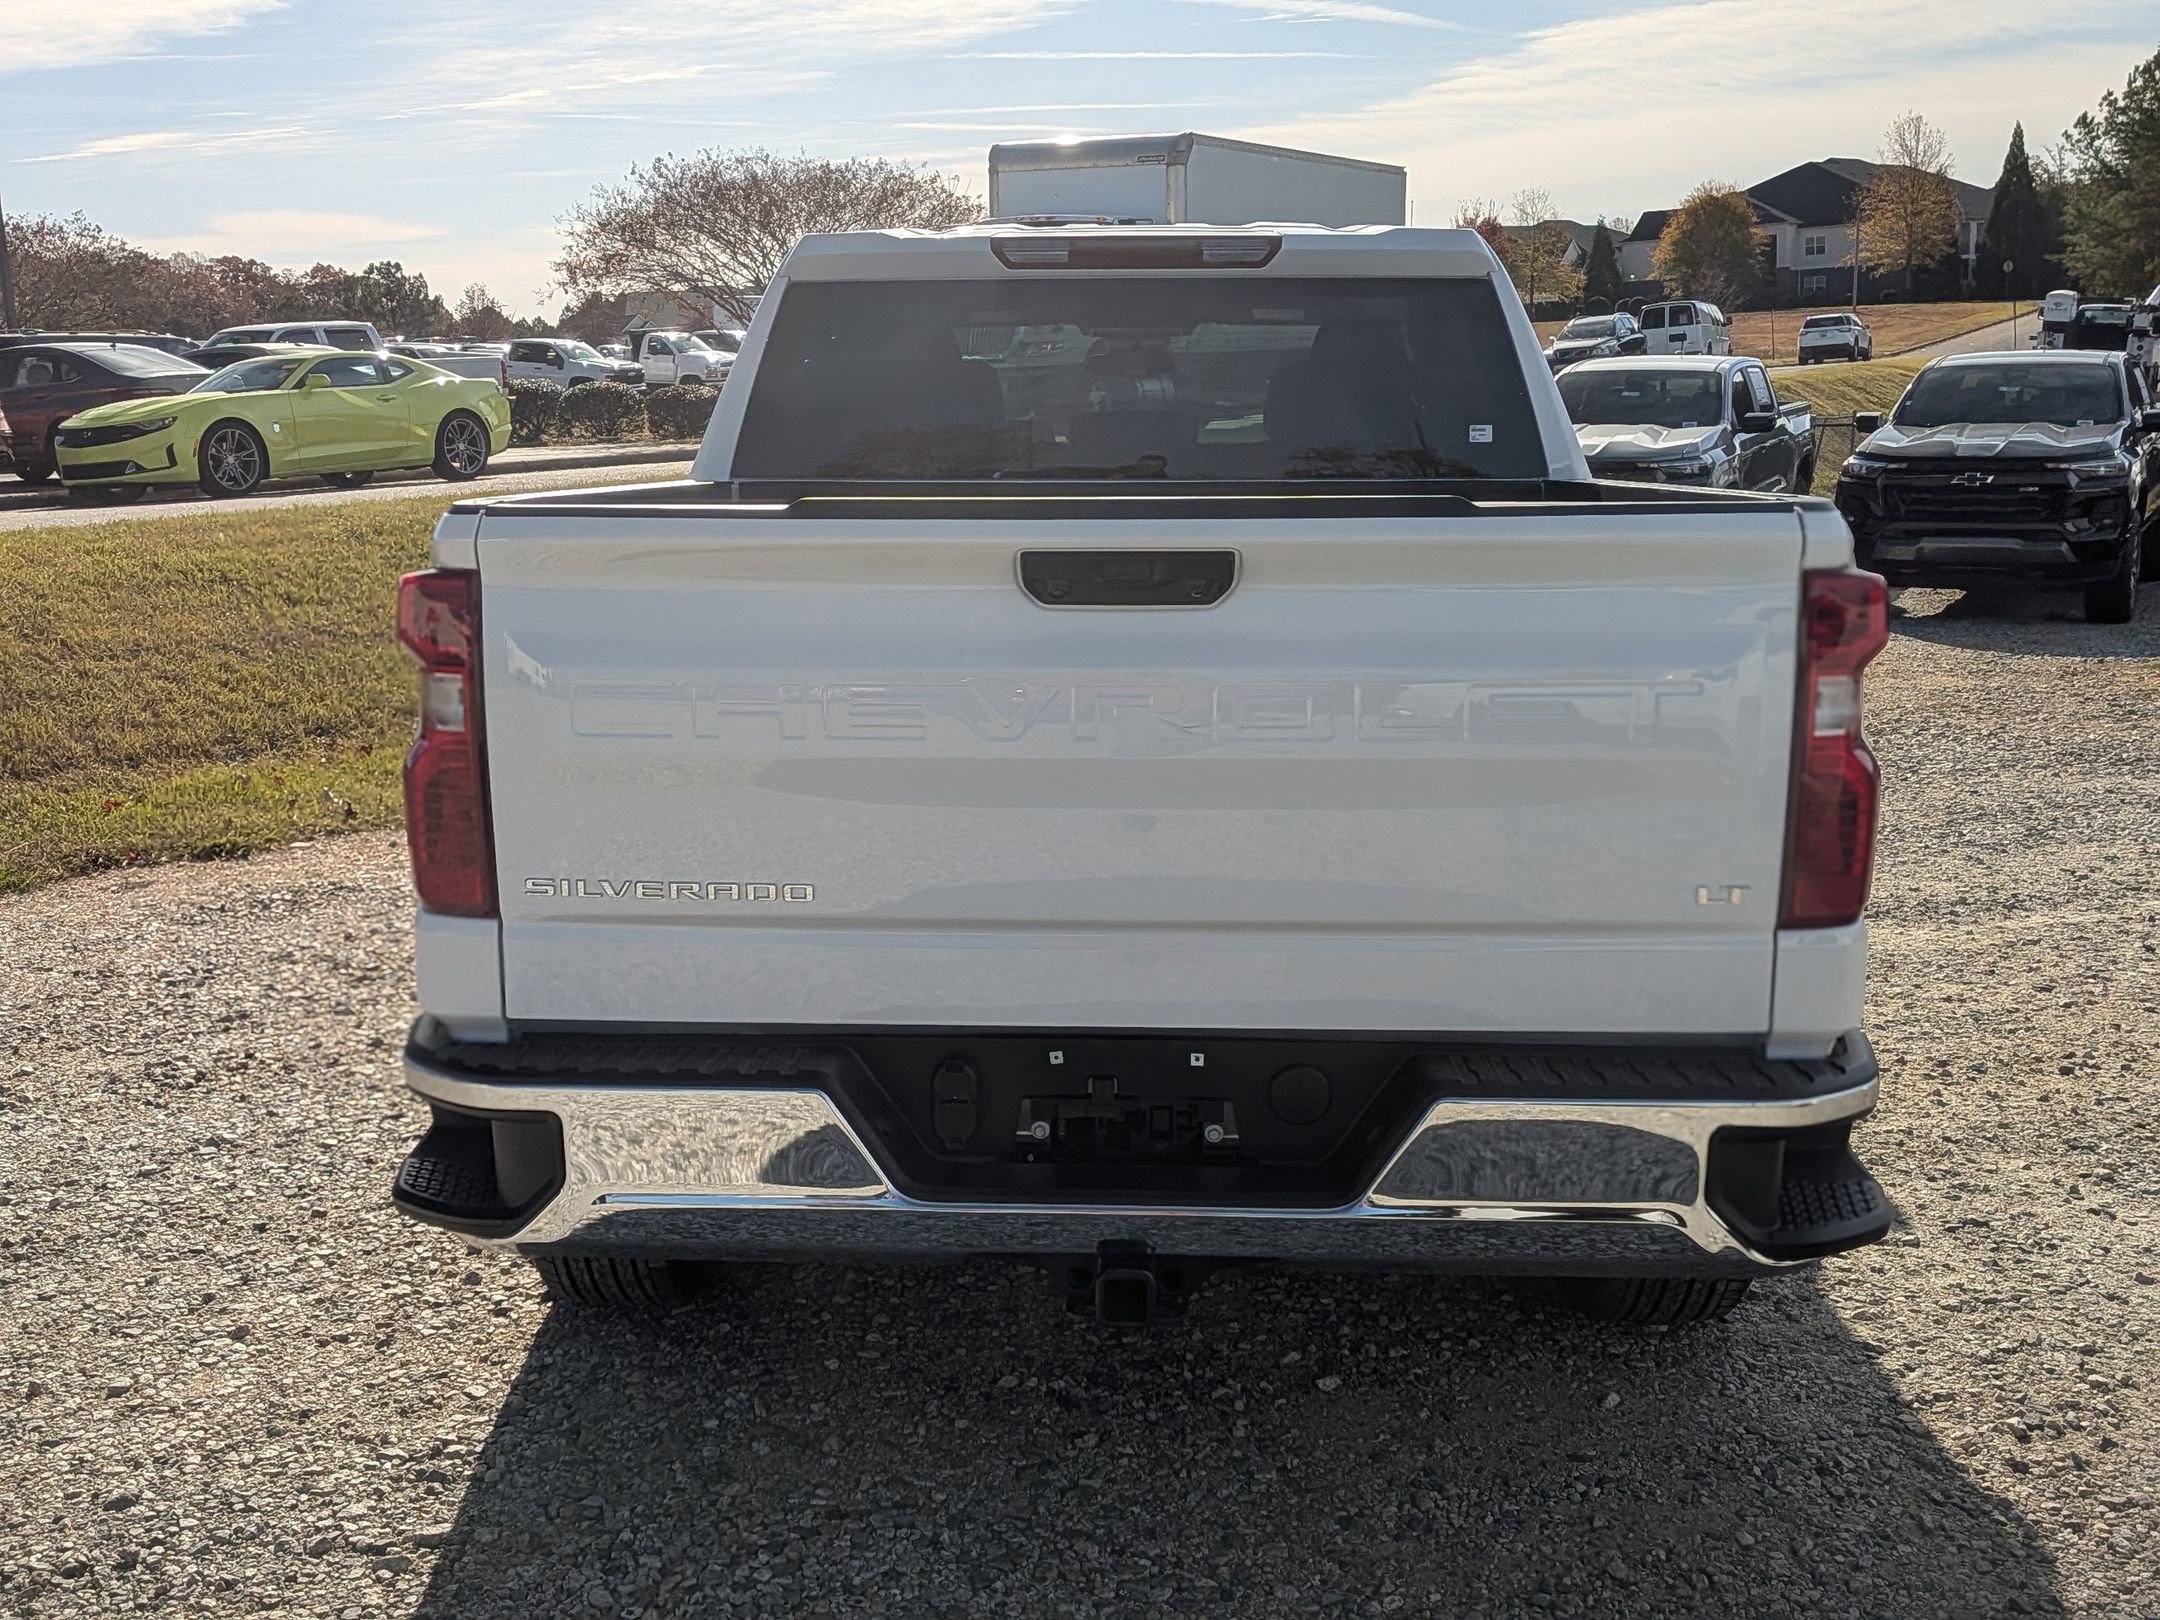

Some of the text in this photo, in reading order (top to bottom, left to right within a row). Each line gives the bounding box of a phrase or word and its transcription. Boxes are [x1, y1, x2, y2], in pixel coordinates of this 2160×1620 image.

[569, 679, 1703, 742] CHEVROLET
[523, 878, 815, 903] SILVERADO
[1695, 885, 1752, 905] LT
